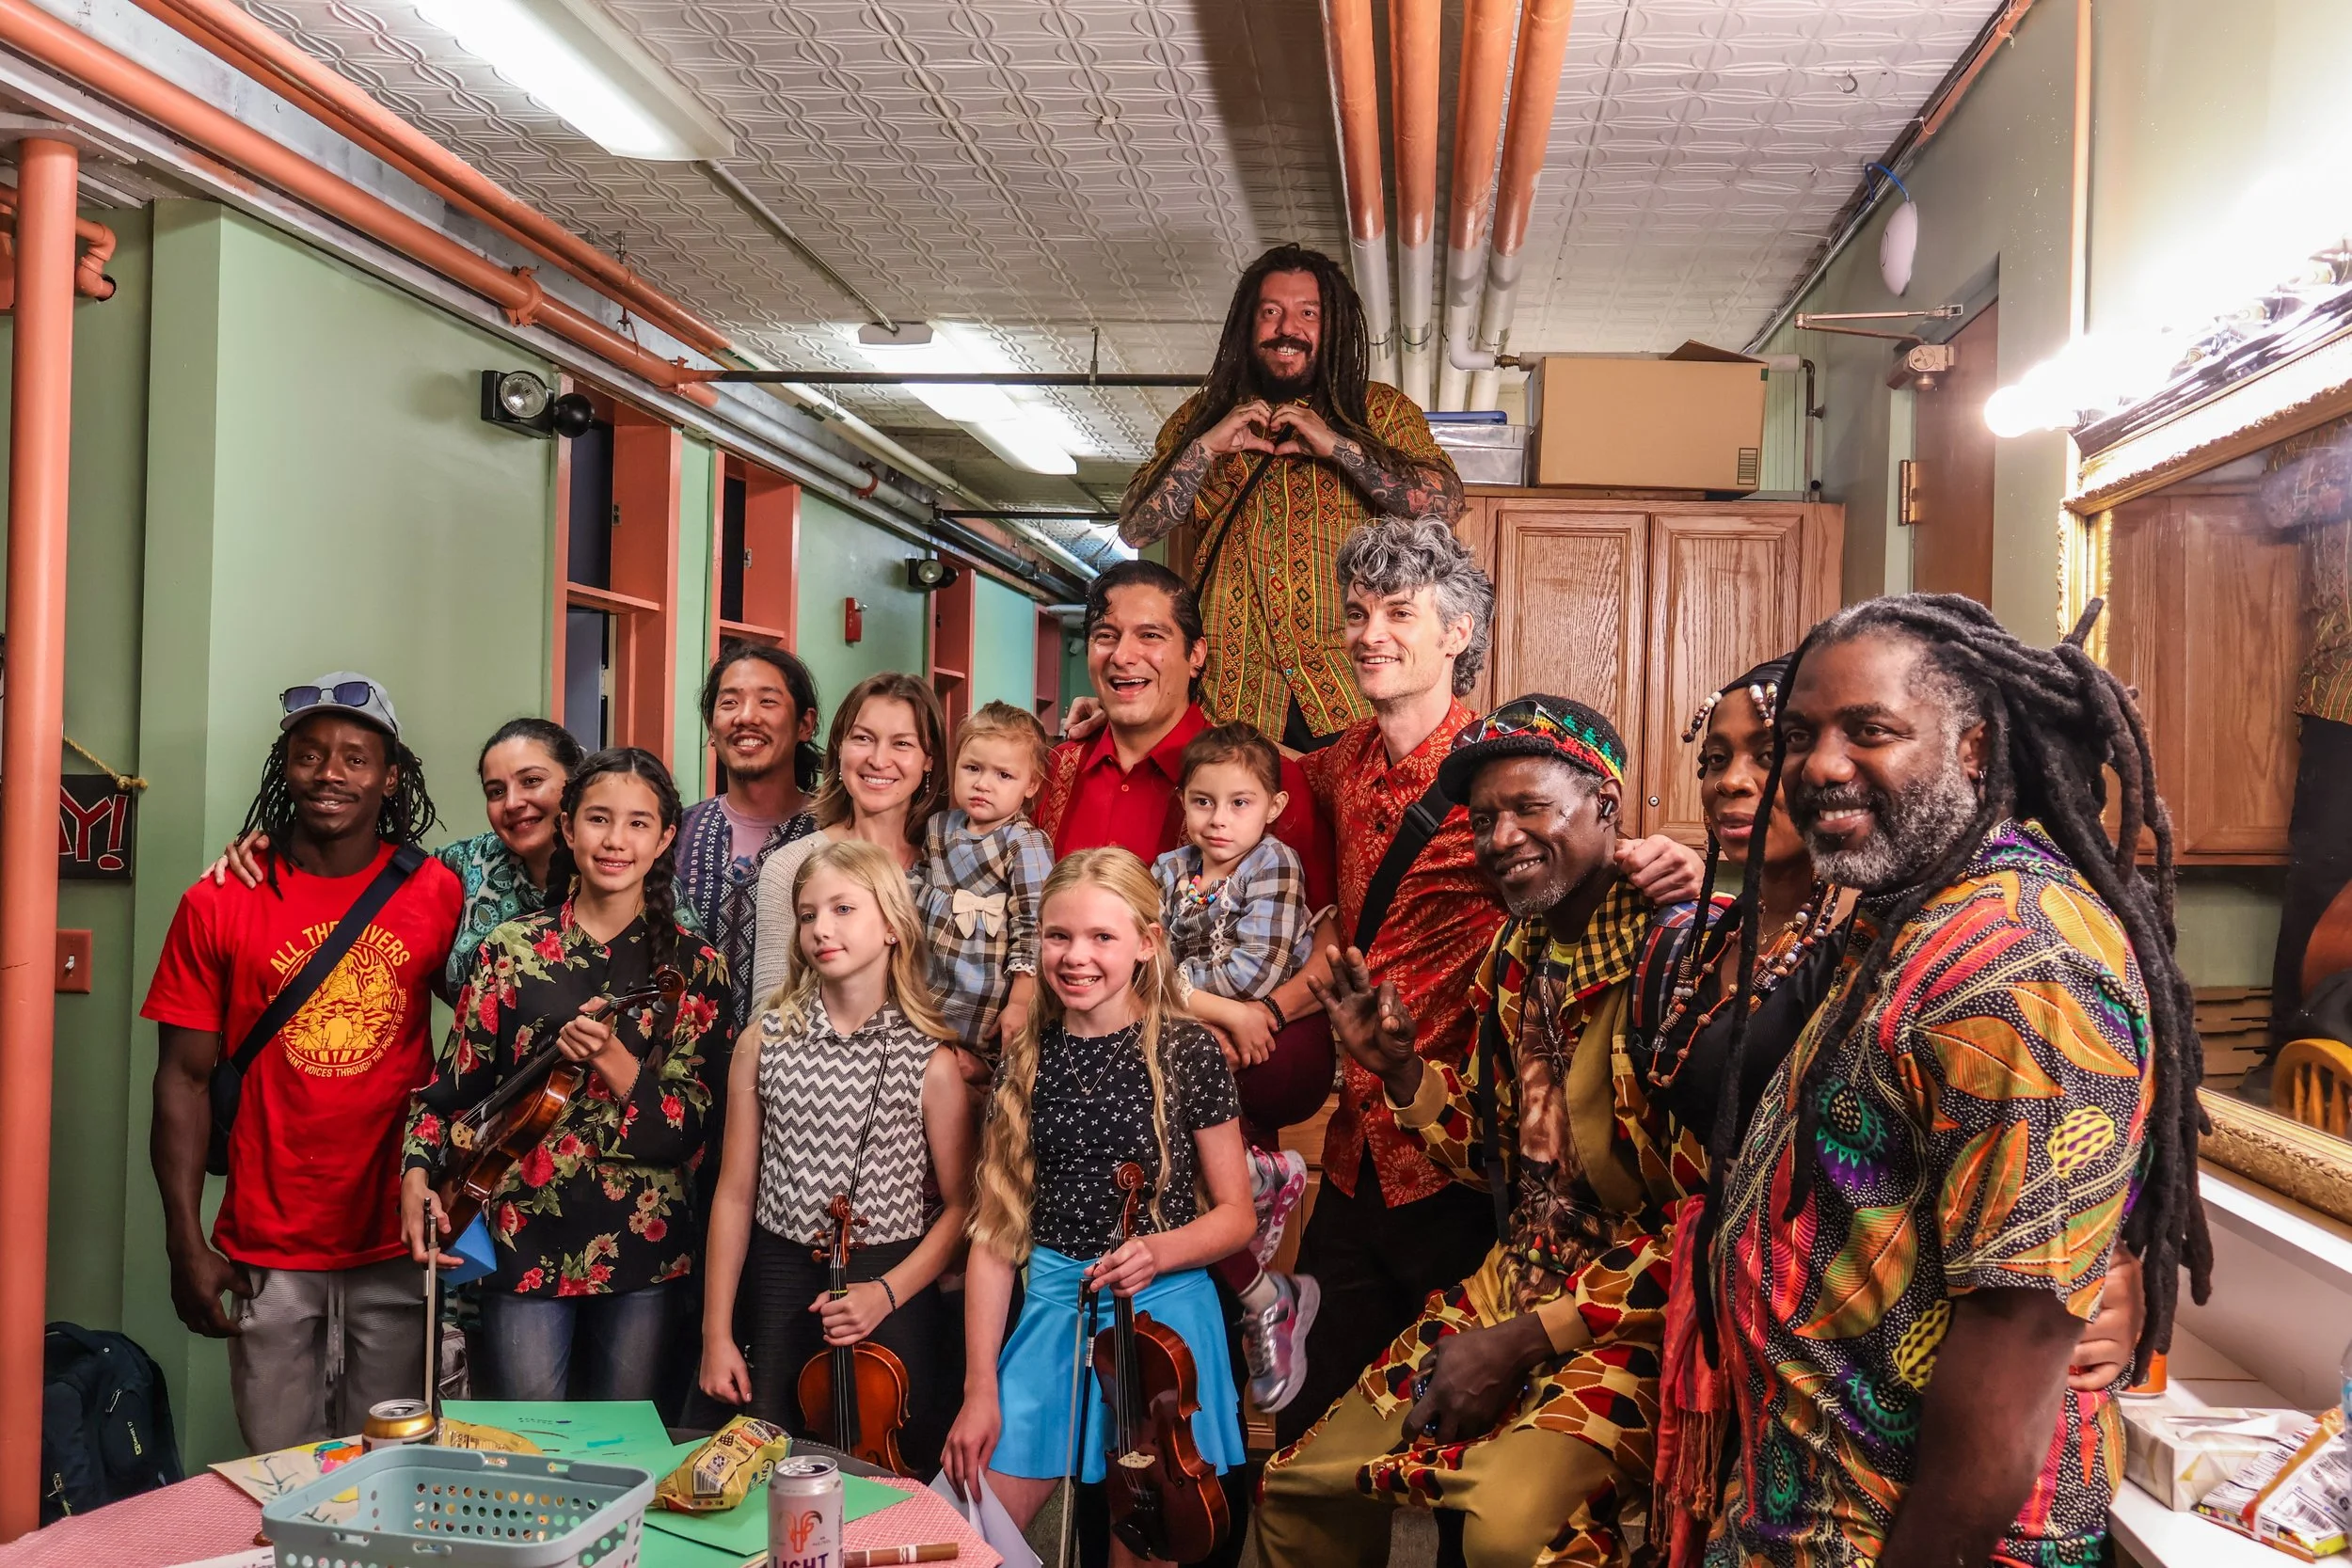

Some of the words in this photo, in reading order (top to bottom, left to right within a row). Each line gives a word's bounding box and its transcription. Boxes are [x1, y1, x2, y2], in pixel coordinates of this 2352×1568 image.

[270, 941, 305, 975] ALL
[357, 923, 411, 967] IVERS
[399, 988, 407, 1012] MUSIC
[395, 1013, 405, 1024] OF
[381, 1024, 400, 1052] POWER
[372, 1049, 385, 1063] THE
[304, 1064, 333, 1078] VOICES
[335, 1060, 373, 1078] THROUGH
